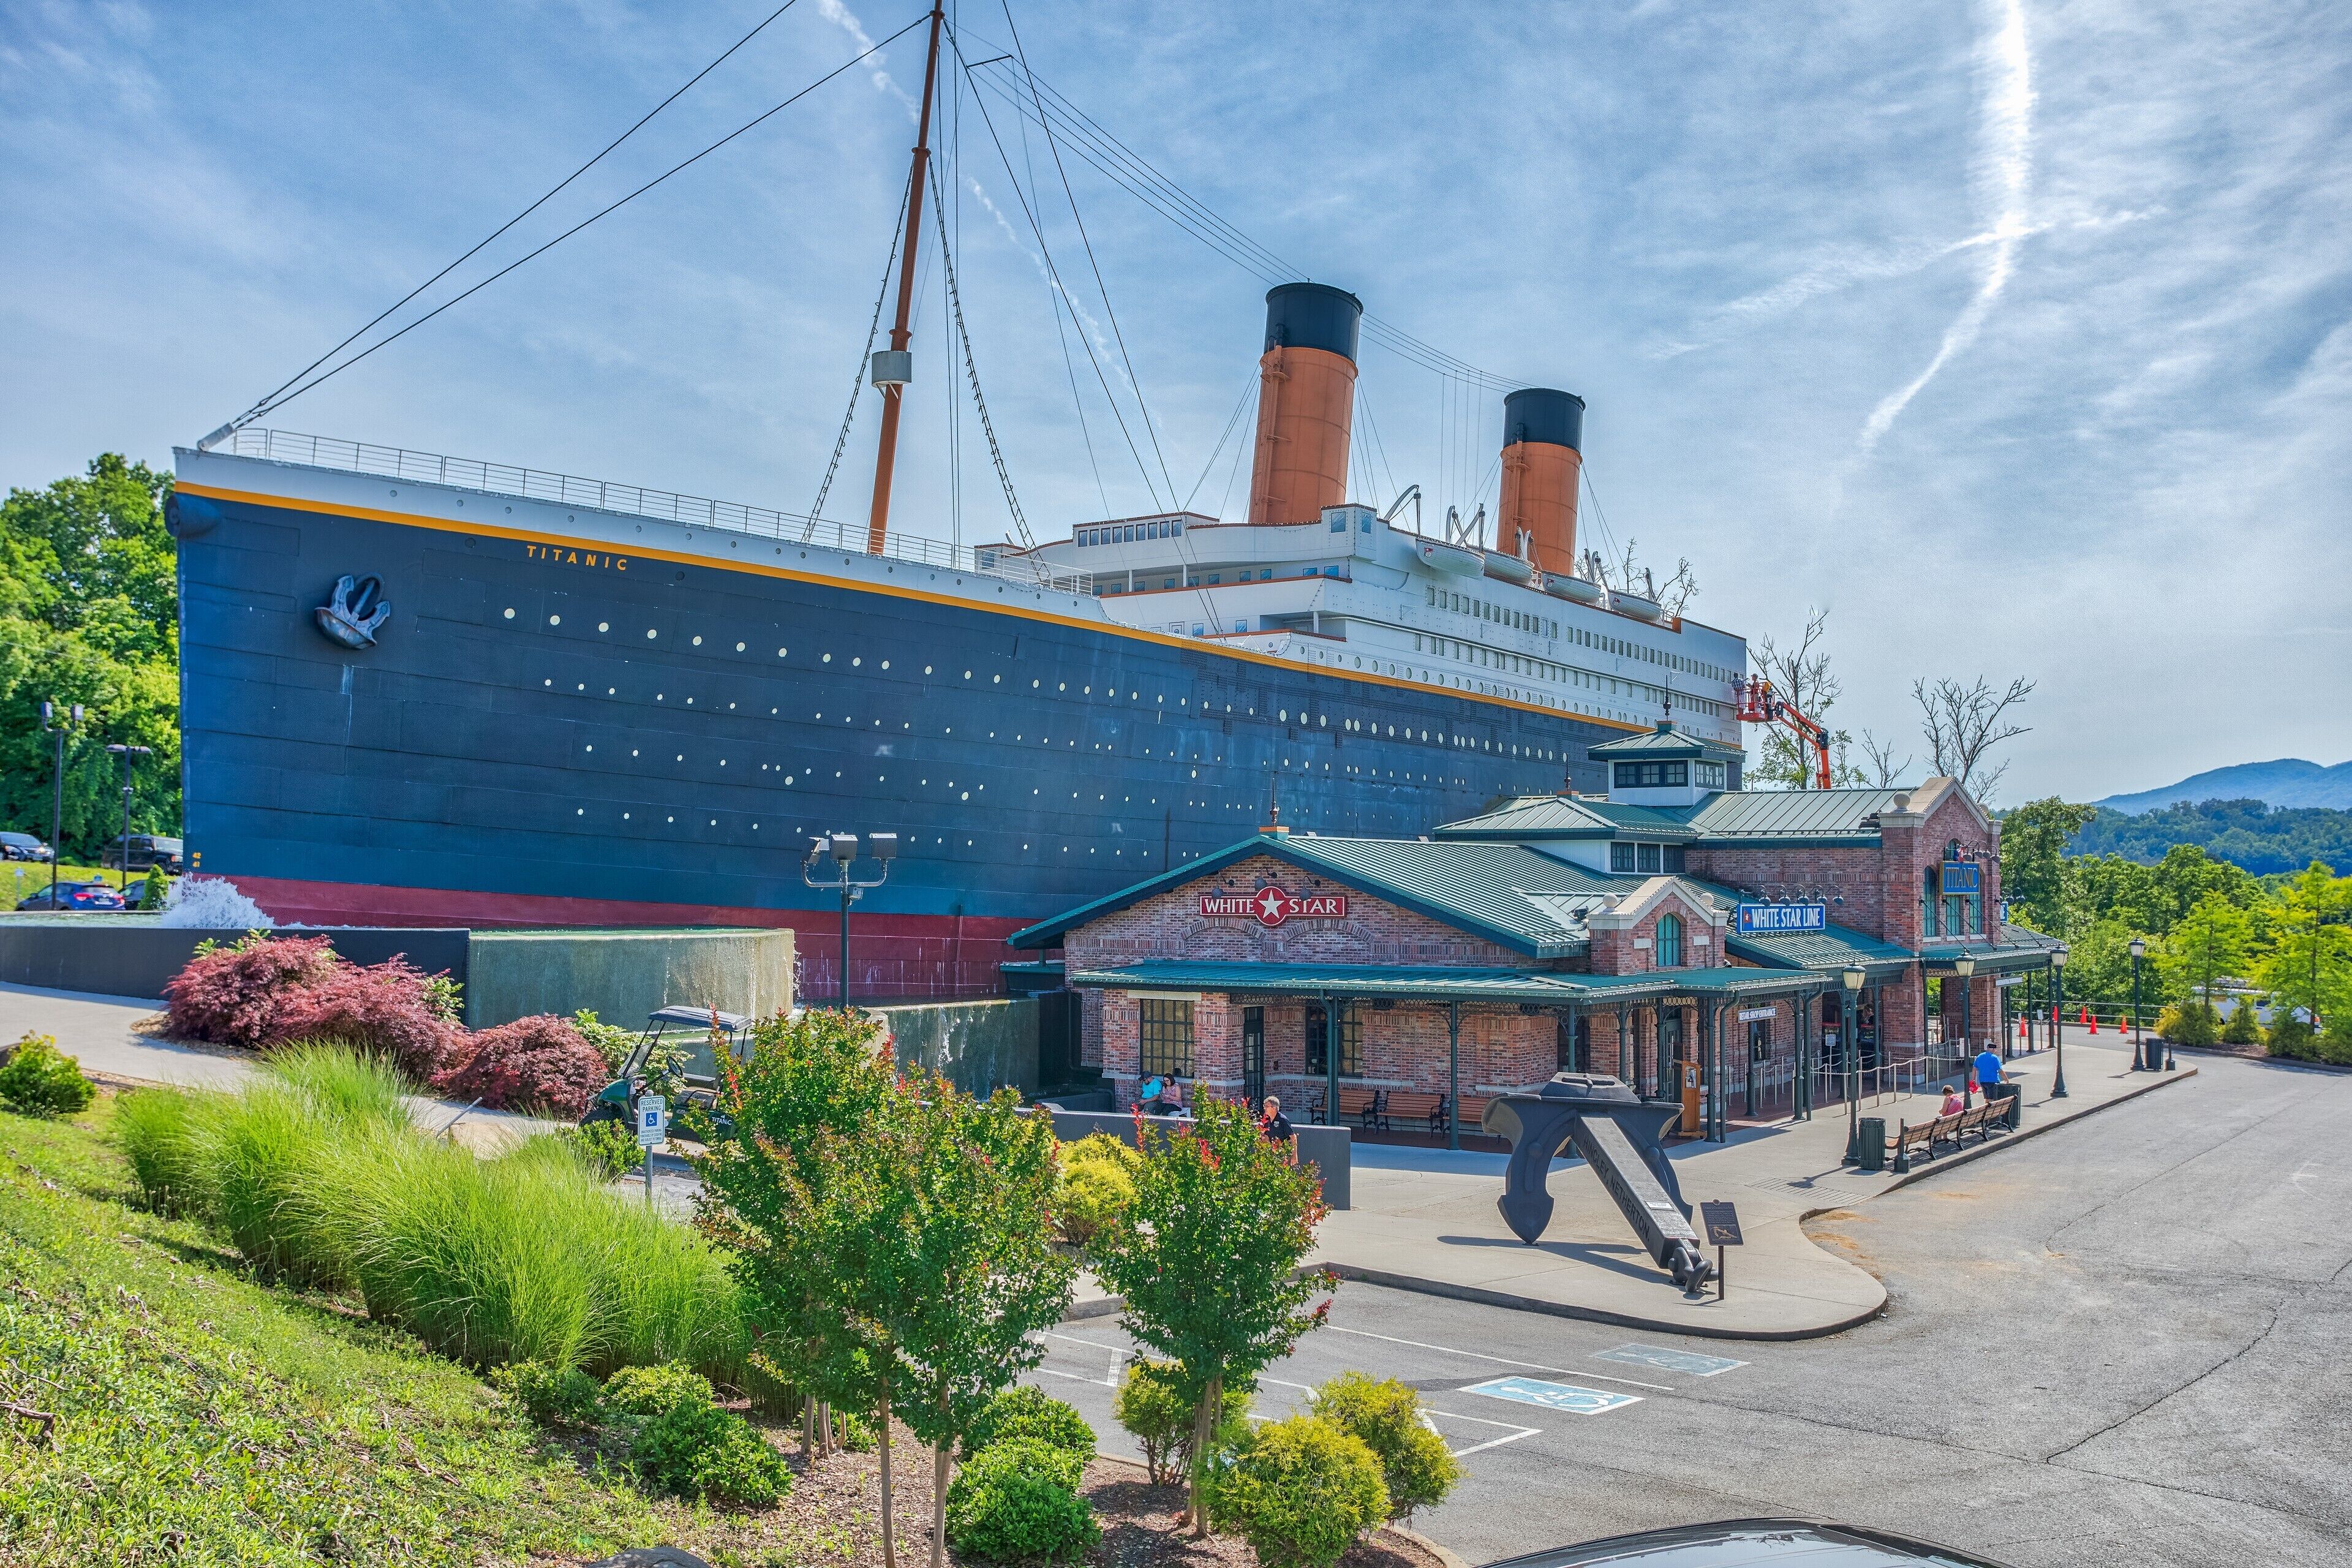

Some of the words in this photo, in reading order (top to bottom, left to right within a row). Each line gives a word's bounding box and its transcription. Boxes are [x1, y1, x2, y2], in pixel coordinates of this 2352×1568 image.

[527, 545, 627, 571] TITANIC
[1945, 867, 1977, 888] TITANIC
[1205, 899, 1254, 913] WHITE
[1289, 899, 1338, 914] STAR
[1752, 908, 1779, 928] WHITE
[1781, 908, 1801, 927] STAR
[1803, 908, 1820, 927] LINE
[1739, 1012, 1749, 1020] RETAIL
[1759, 1008, 1776, 1017] ENTRANCE
[711, 1117, 733, 1125] TITANIC
[1610, 1175, 1650, 1242] NETHERTON.
